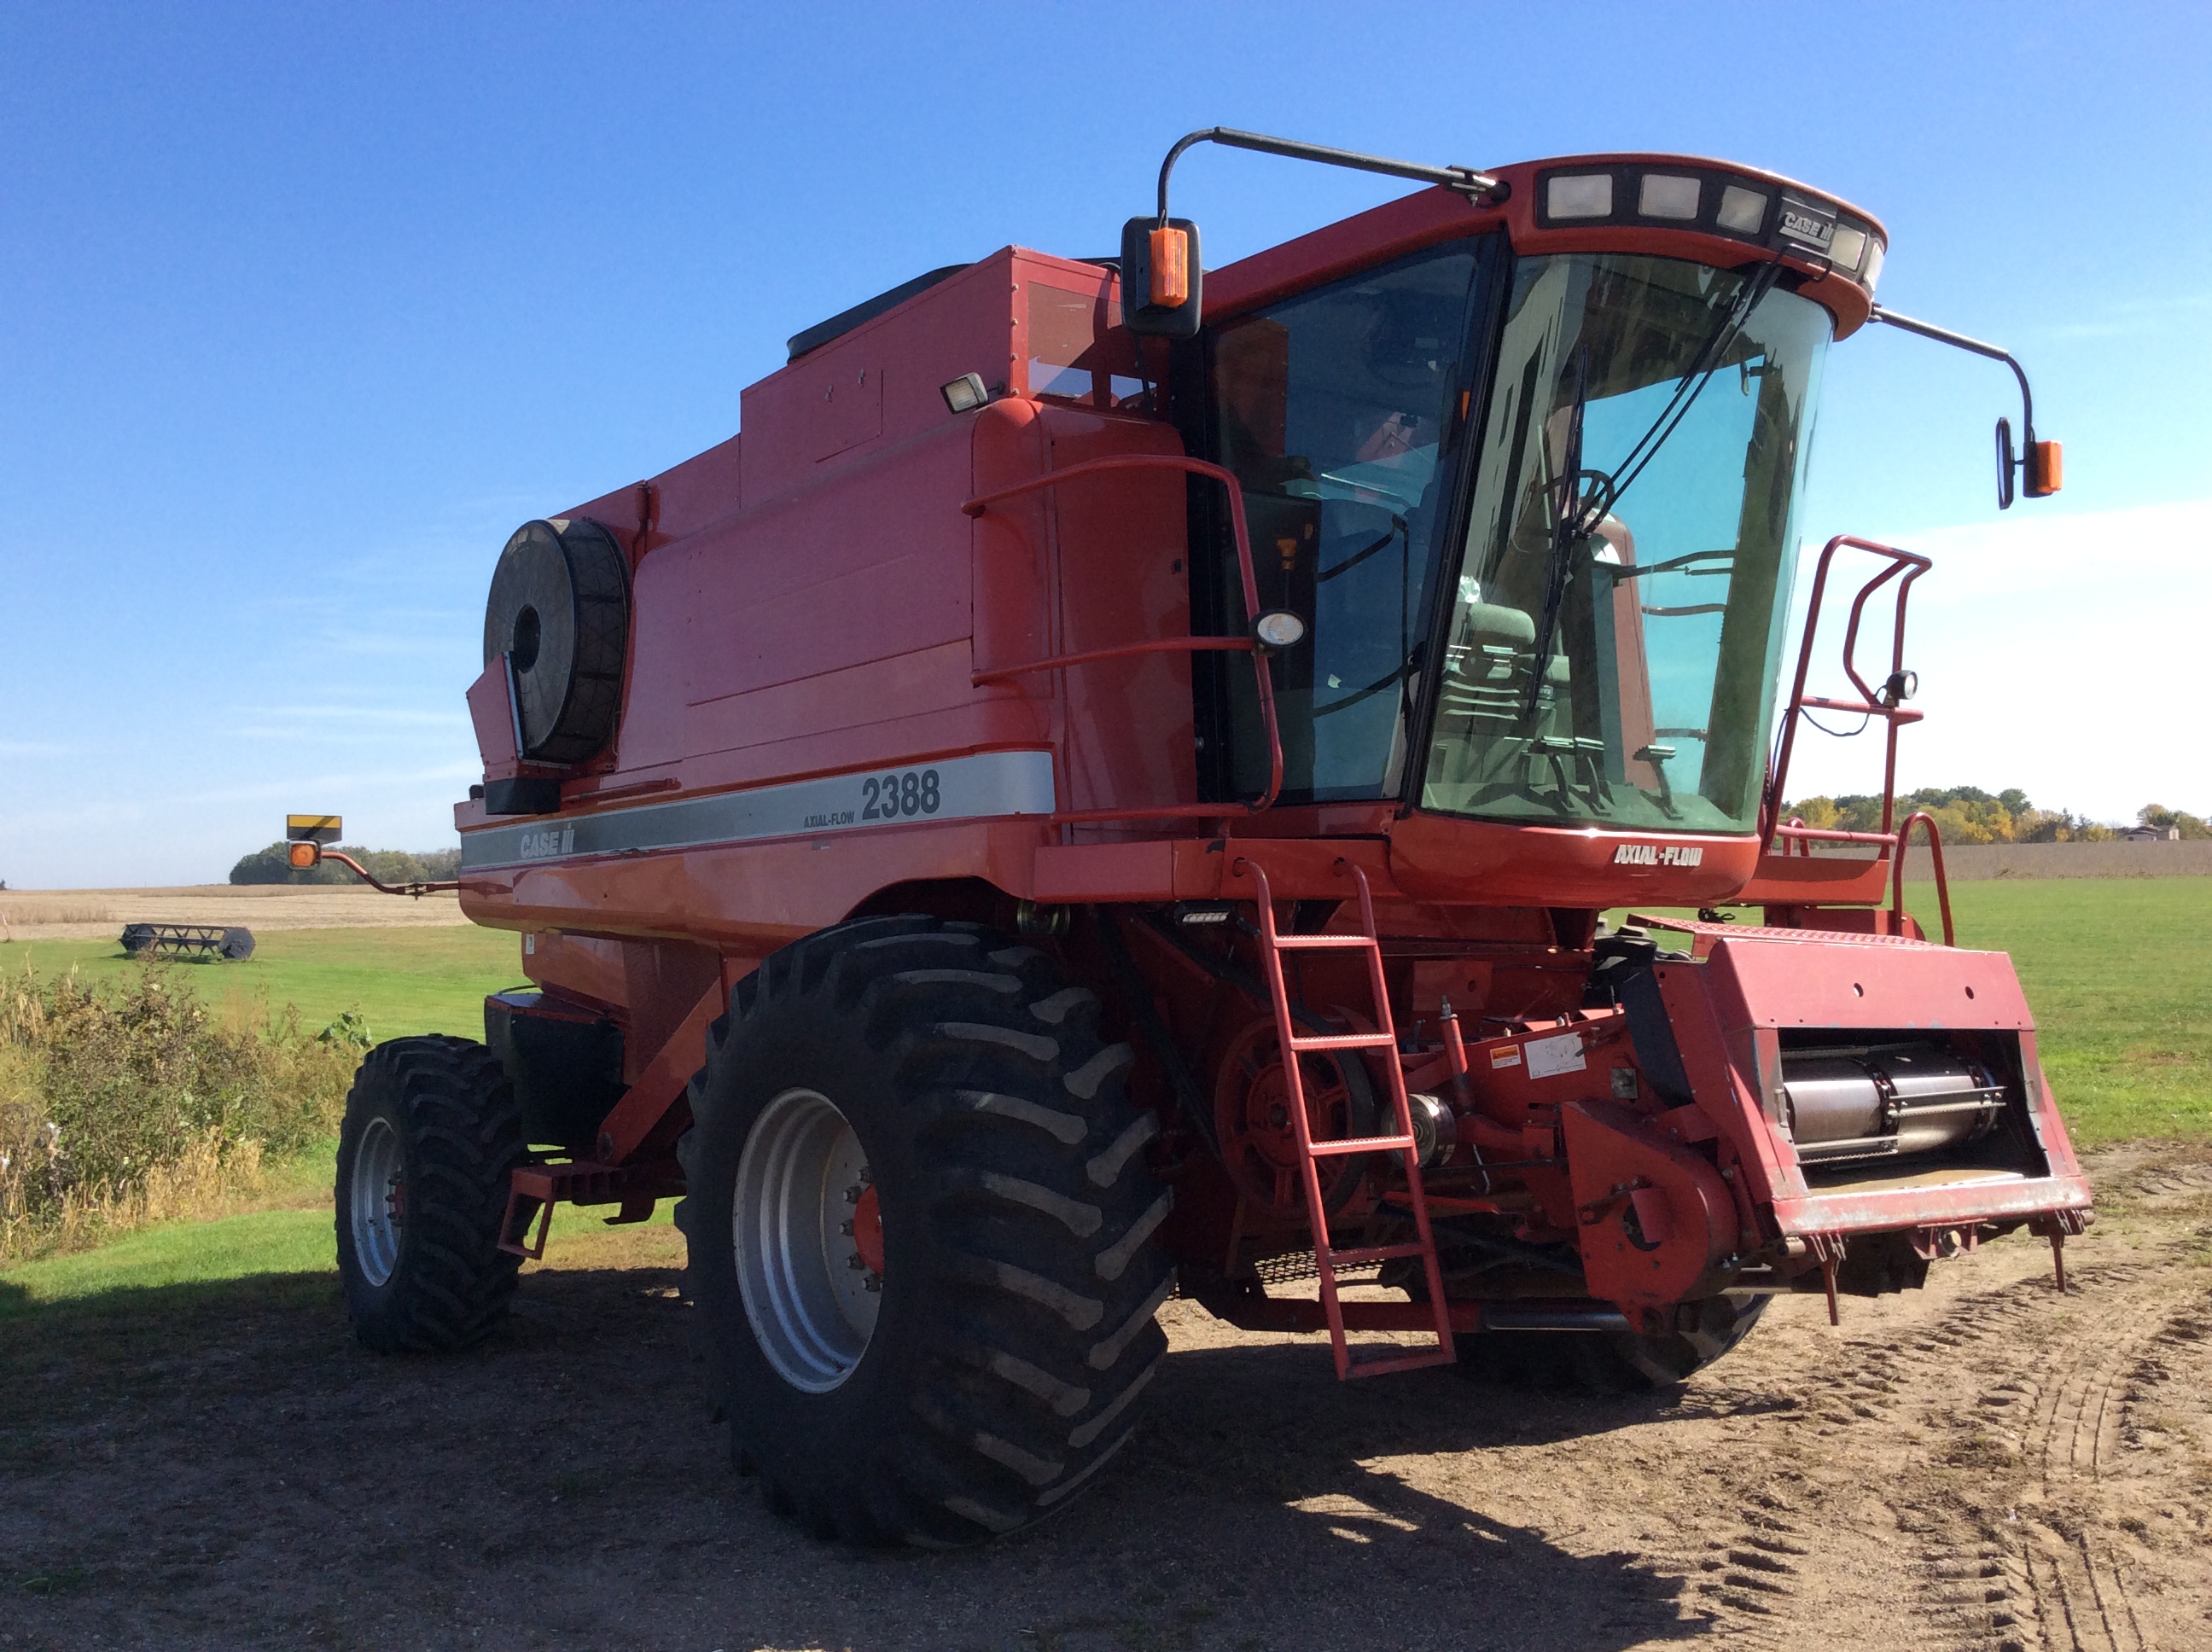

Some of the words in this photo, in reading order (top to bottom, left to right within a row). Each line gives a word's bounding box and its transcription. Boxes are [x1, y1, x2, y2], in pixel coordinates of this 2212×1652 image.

[1784, 212, 1821, 237] CASE
[804, 811, 855, 829] AXIAL-FLOW
[862, 769, 940, 821] 2388
[521, 831, 560, 859] CASE
[1614, 844, 1703, 867] AXIAL-FLOW
